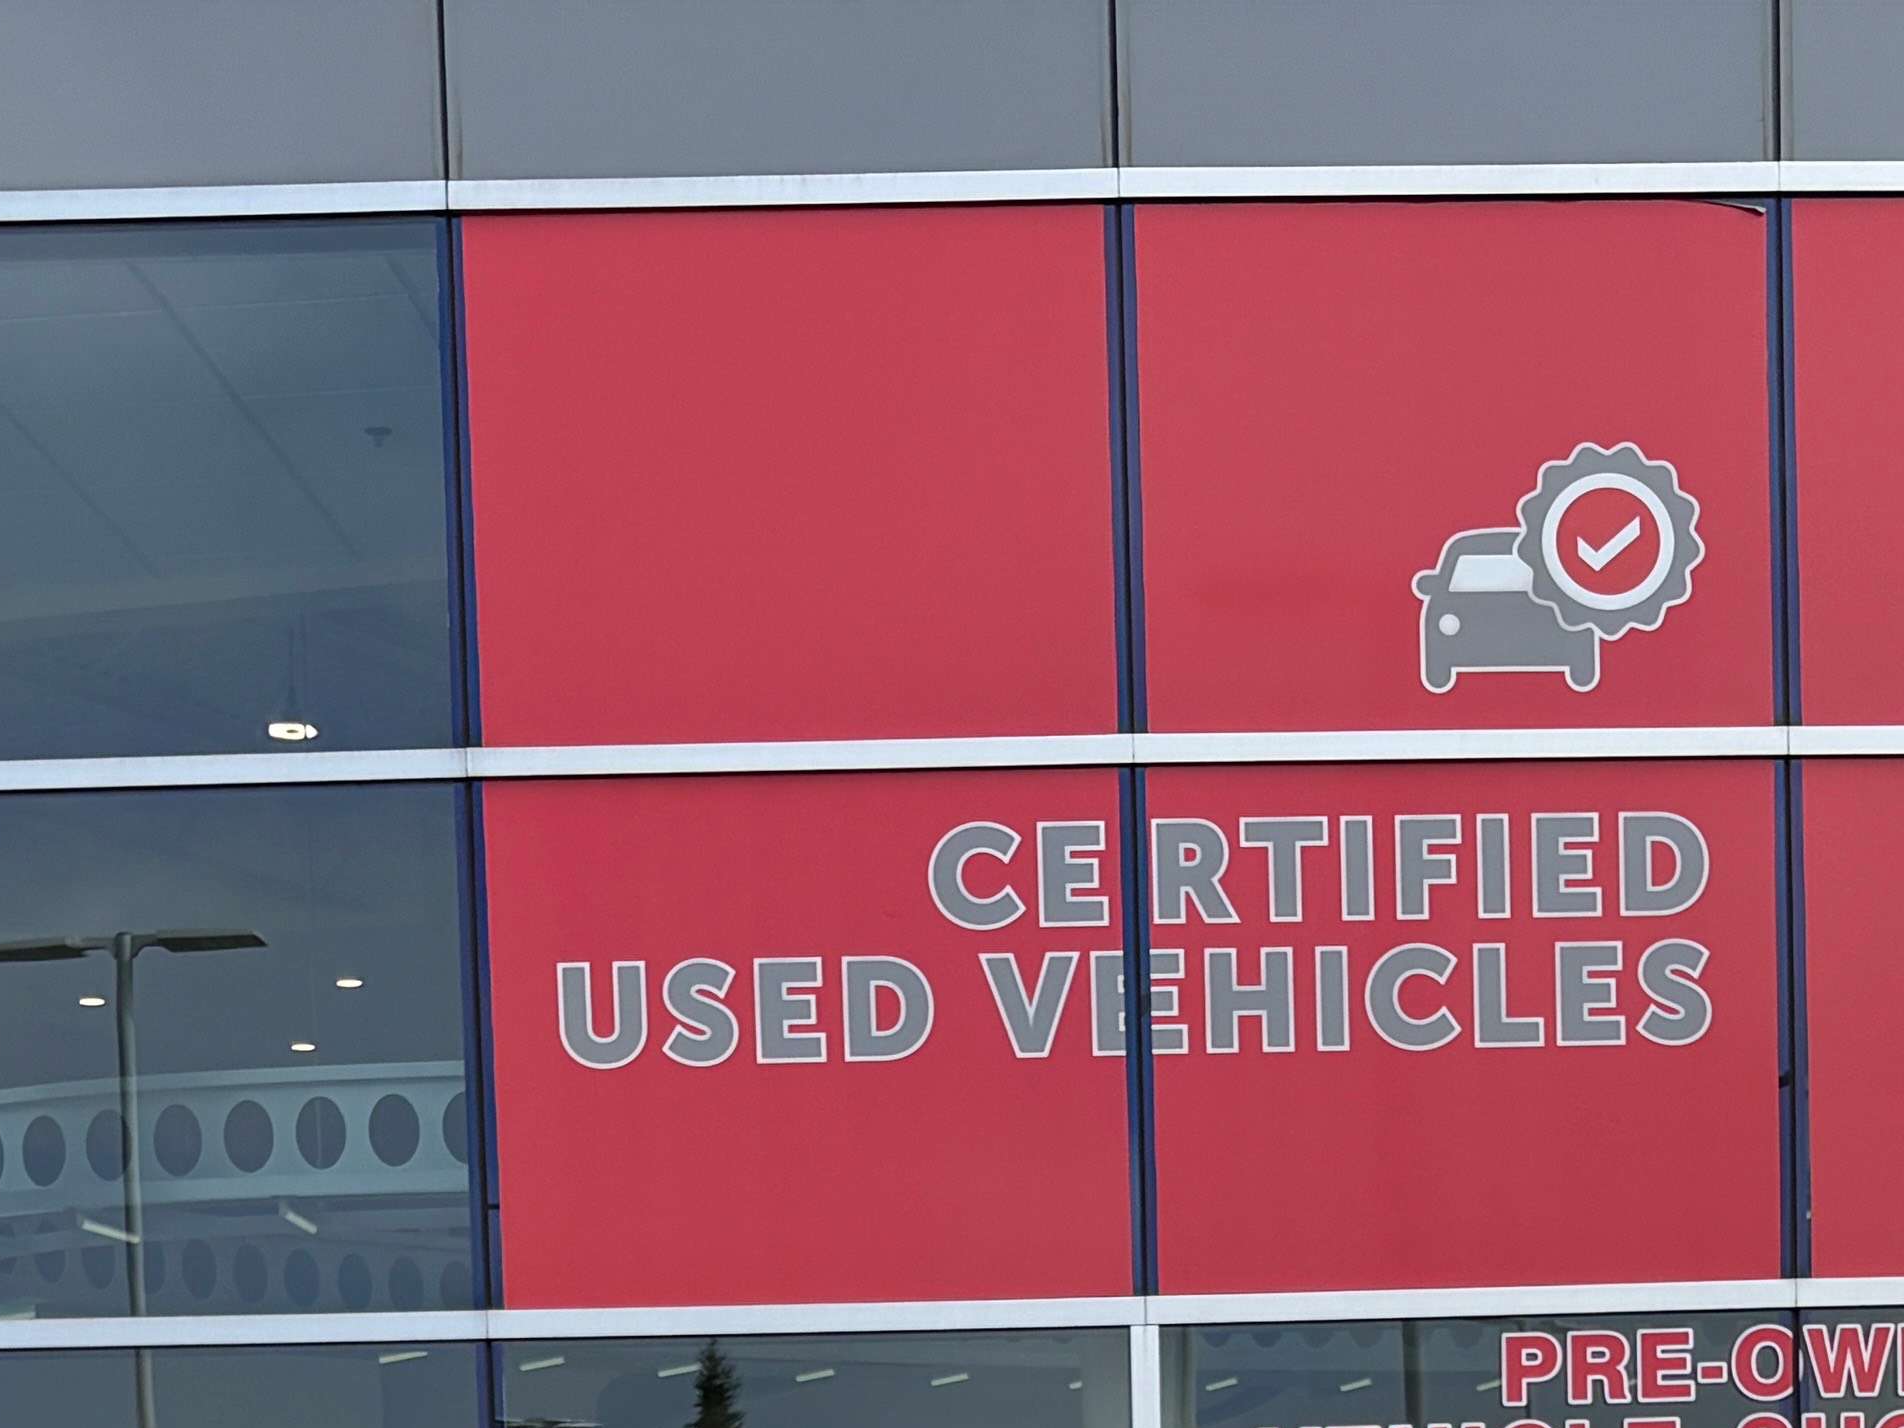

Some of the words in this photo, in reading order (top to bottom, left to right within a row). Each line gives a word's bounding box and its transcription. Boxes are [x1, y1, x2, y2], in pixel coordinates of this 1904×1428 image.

[928, 811, 1711, 930] CERTIFIED
[555, 954, 935, 1070] USED
[979, 938, 1713, 1060] VEHICLES
